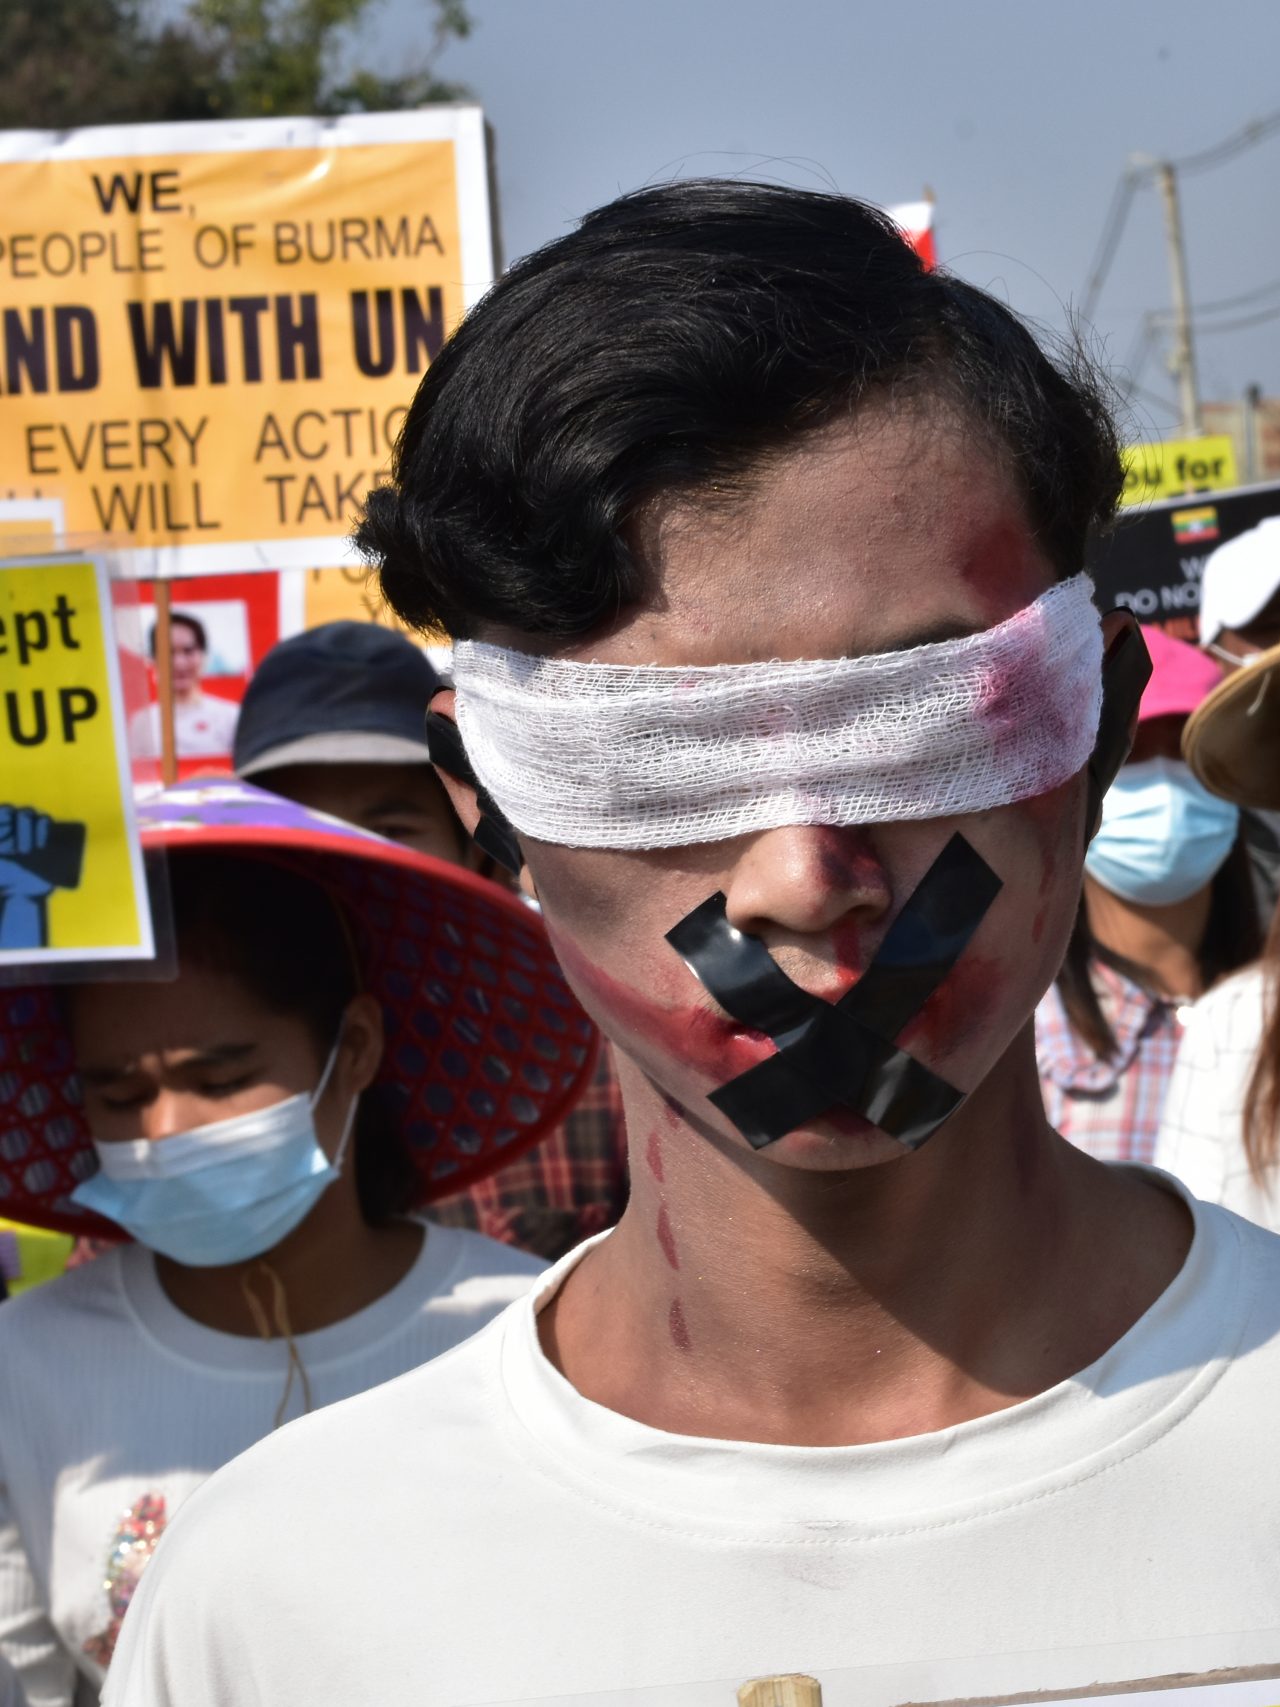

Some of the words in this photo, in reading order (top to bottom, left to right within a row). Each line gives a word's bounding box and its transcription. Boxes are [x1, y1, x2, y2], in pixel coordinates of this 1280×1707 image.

[194, 223, 258, 270] OF
[274, 214, 446, 266] BURMA
[0, 304, 101, 395] ND
[127, 292, 322, 389] WITH
[25, 416, 209, 475] EVERY
[1176, 455, 1225, 482] for
[92, 479, 221, 533] WILL
[4, 684, 98, 749] UP
